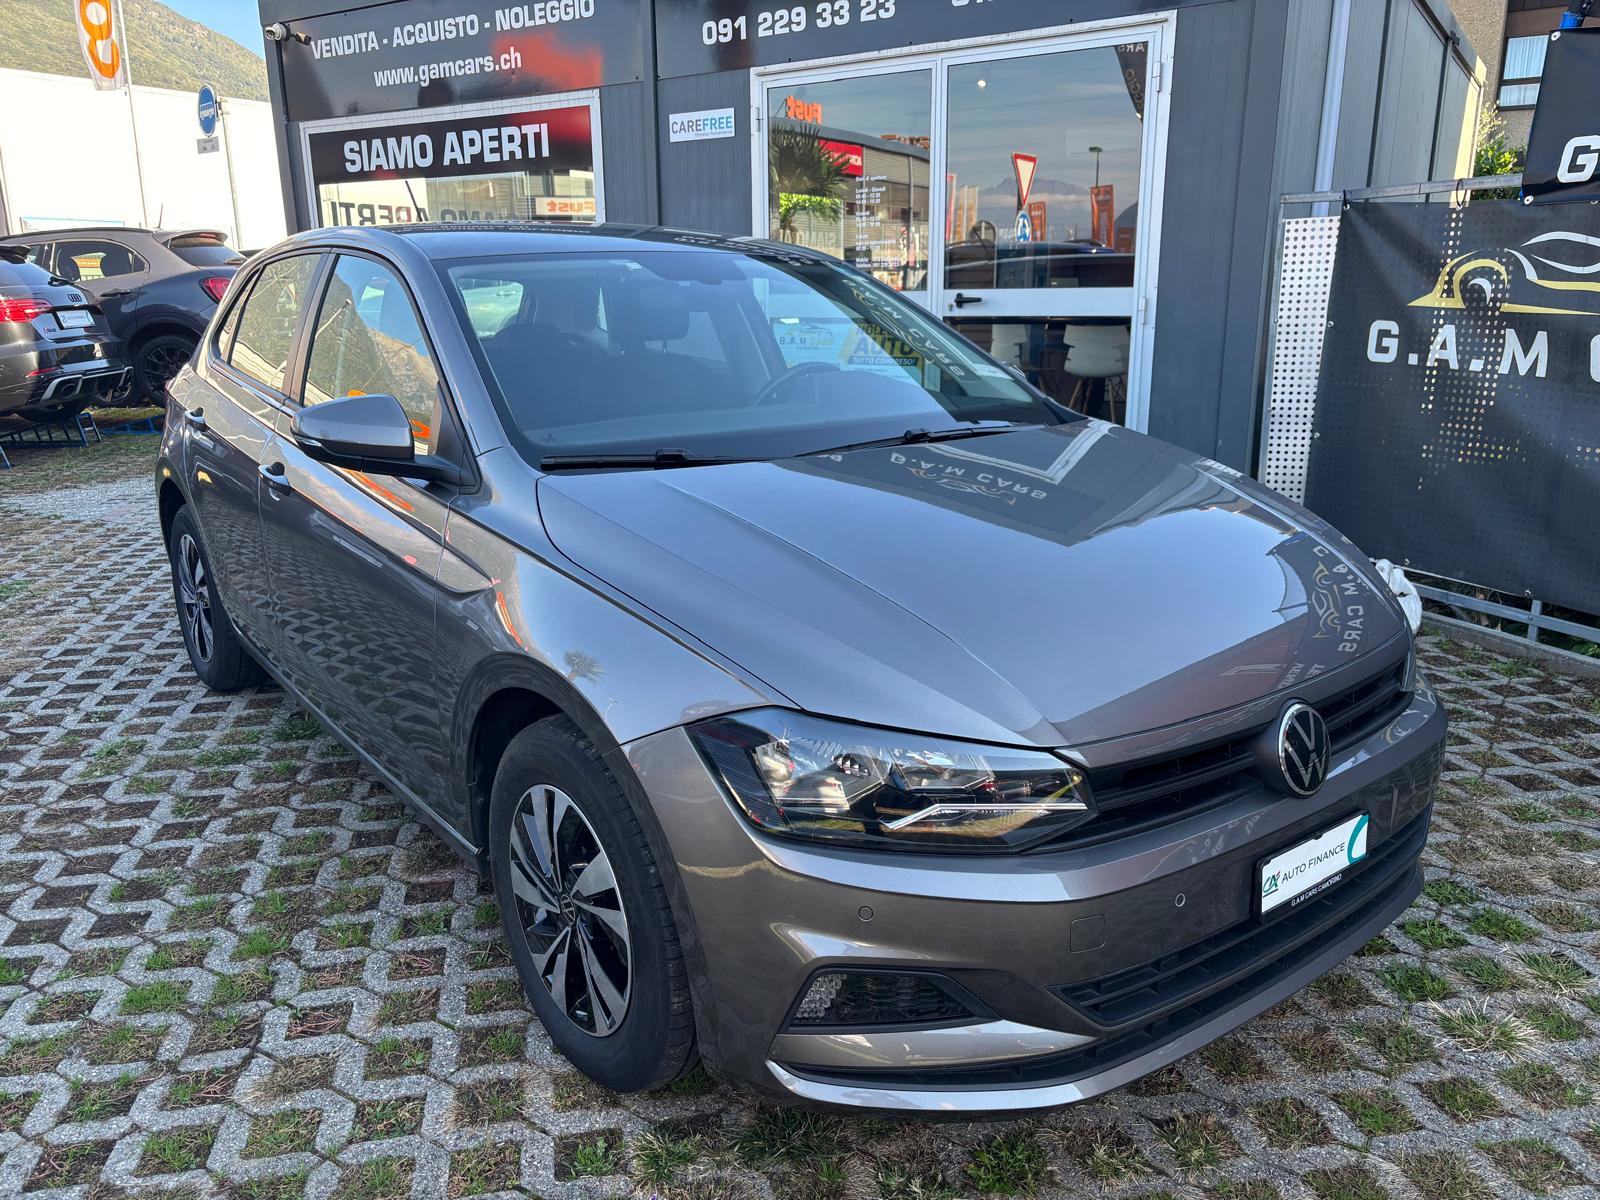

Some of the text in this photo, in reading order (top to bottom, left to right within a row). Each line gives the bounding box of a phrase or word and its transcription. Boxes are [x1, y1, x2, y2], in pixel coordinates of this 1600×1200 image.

[311, 30, 379, 60] VENDITA
[392, 14, 479, 48] ACQUISTO
[495, 0, 595, 32] NOLEGGIO
[702, 0, 896, 46] 091 229 33 23
[374, 46, 522, 88] www.gamcars.ch
[671, 116, 733, 134] CAREFREE
[343, 123, 550, 173] SIAMO APERTI
[853, 336, 914, 356] AUTO
[853, 357, 874, 365] TUTTO
[1367, 319, 1549, 378] G.A.M
[1282, 864, 1306, 884] AUTO
[1308, 842, 1346, 869] FINANCE
[1305, 887, 1318, 899] CARS
[1318, 873, 1343, 892] CAMORINO
